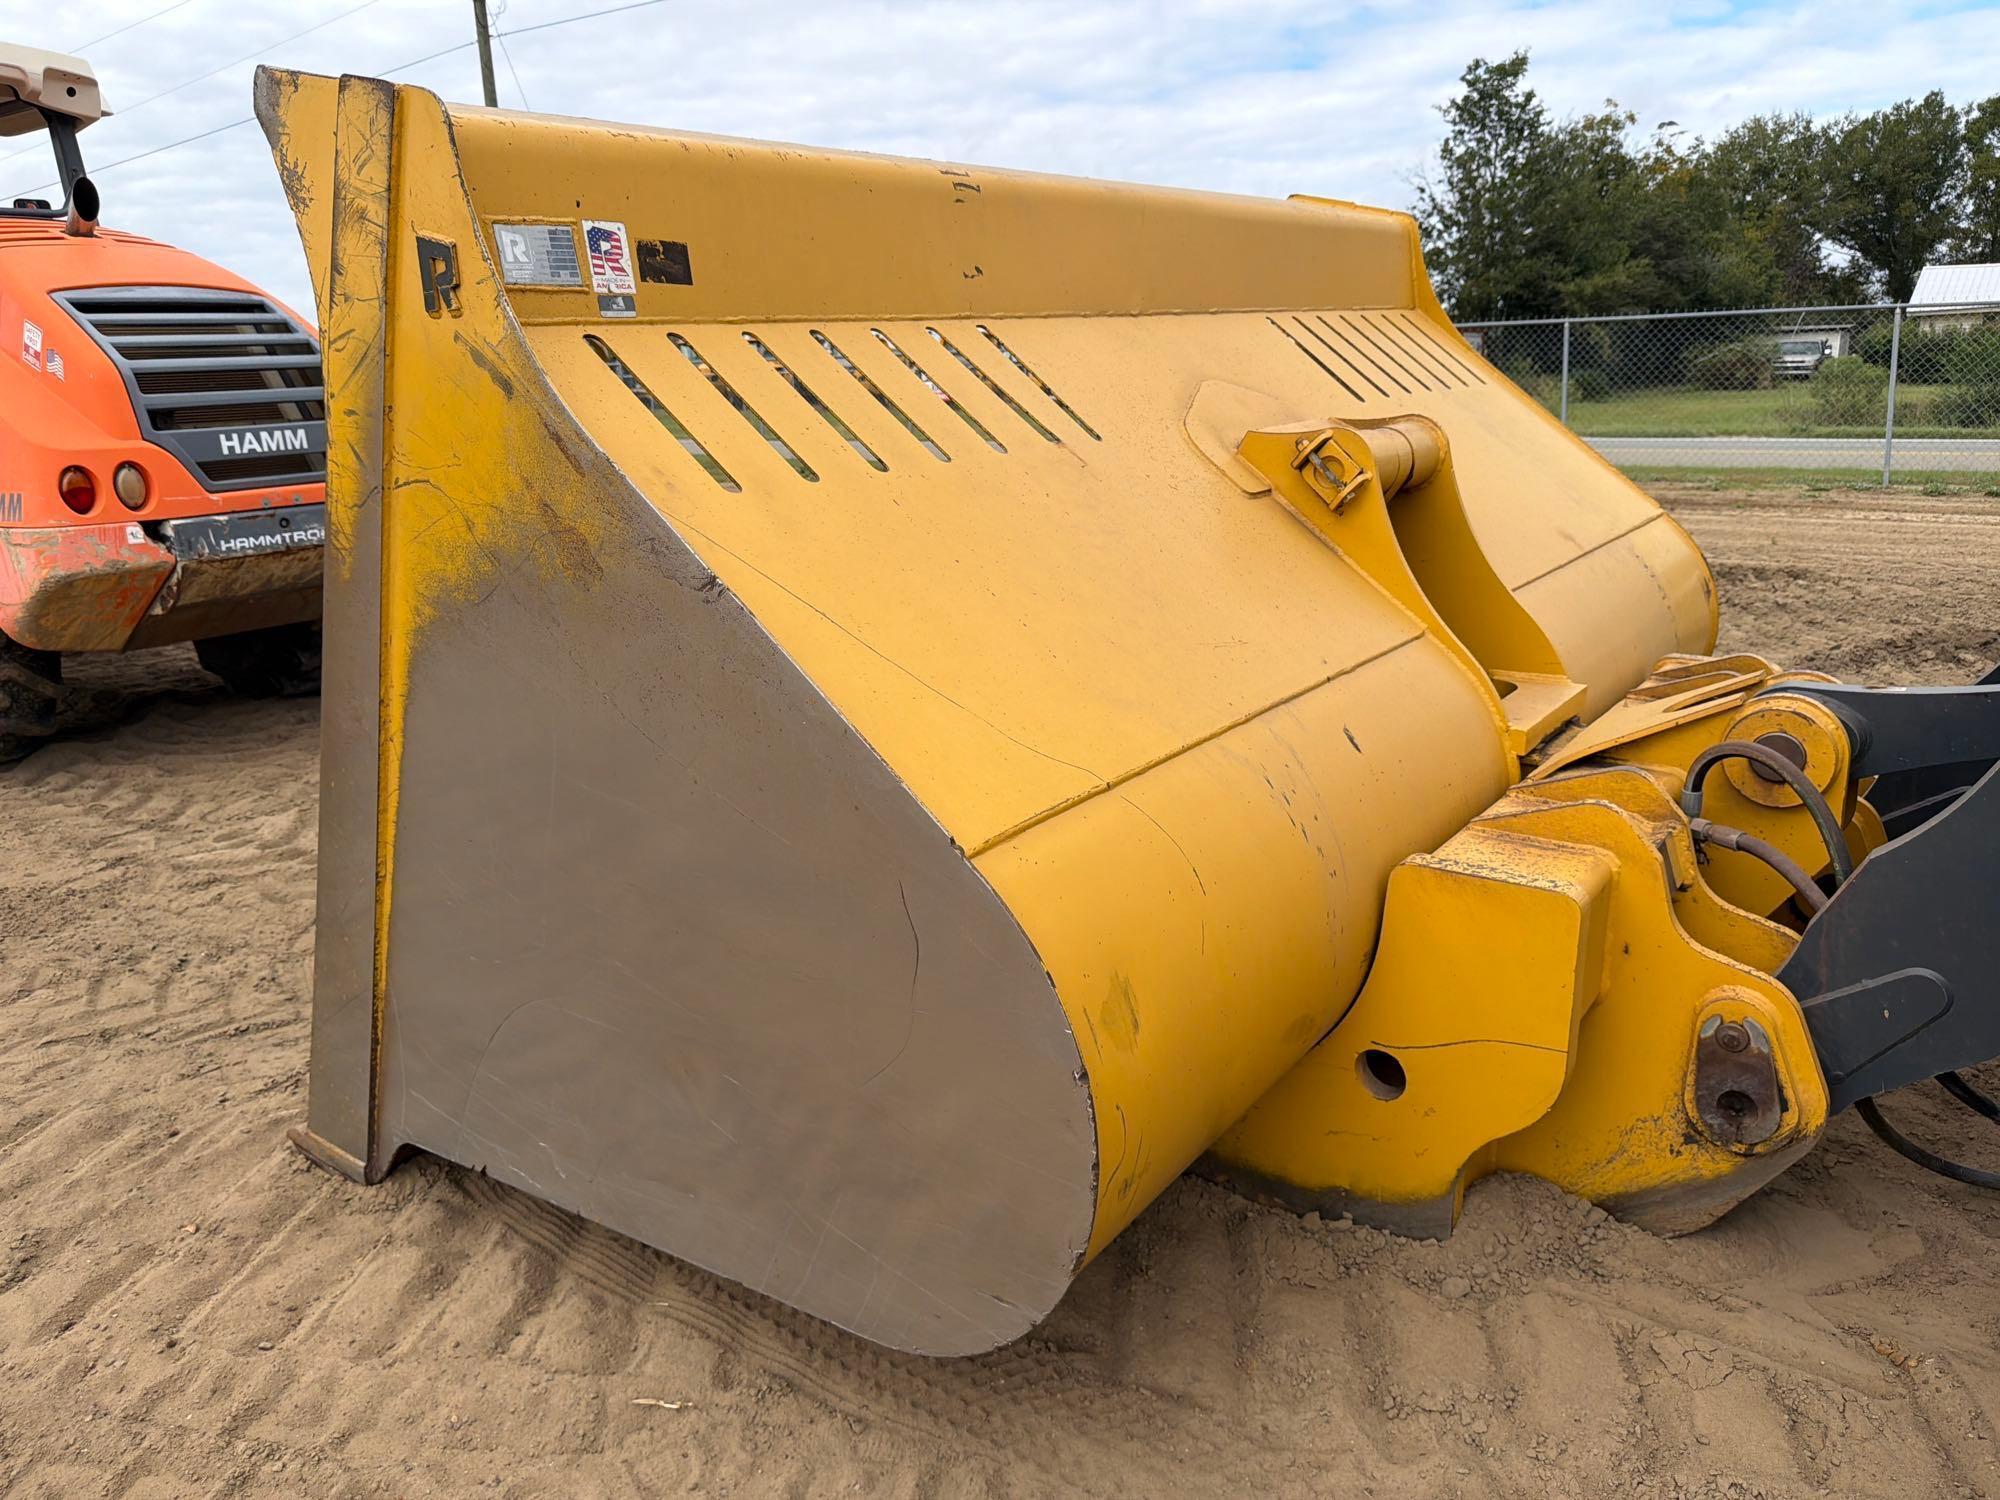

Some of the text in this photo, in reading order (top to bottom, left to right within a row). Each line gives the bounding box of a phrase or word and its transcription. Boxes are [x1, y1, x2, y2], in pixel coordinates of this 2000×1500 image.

[500, 230, 530, 263] R
[587, 226, 629, 277] R
[416, 235, 462, 316] R
[219, 428, 309, 455] HAMM
